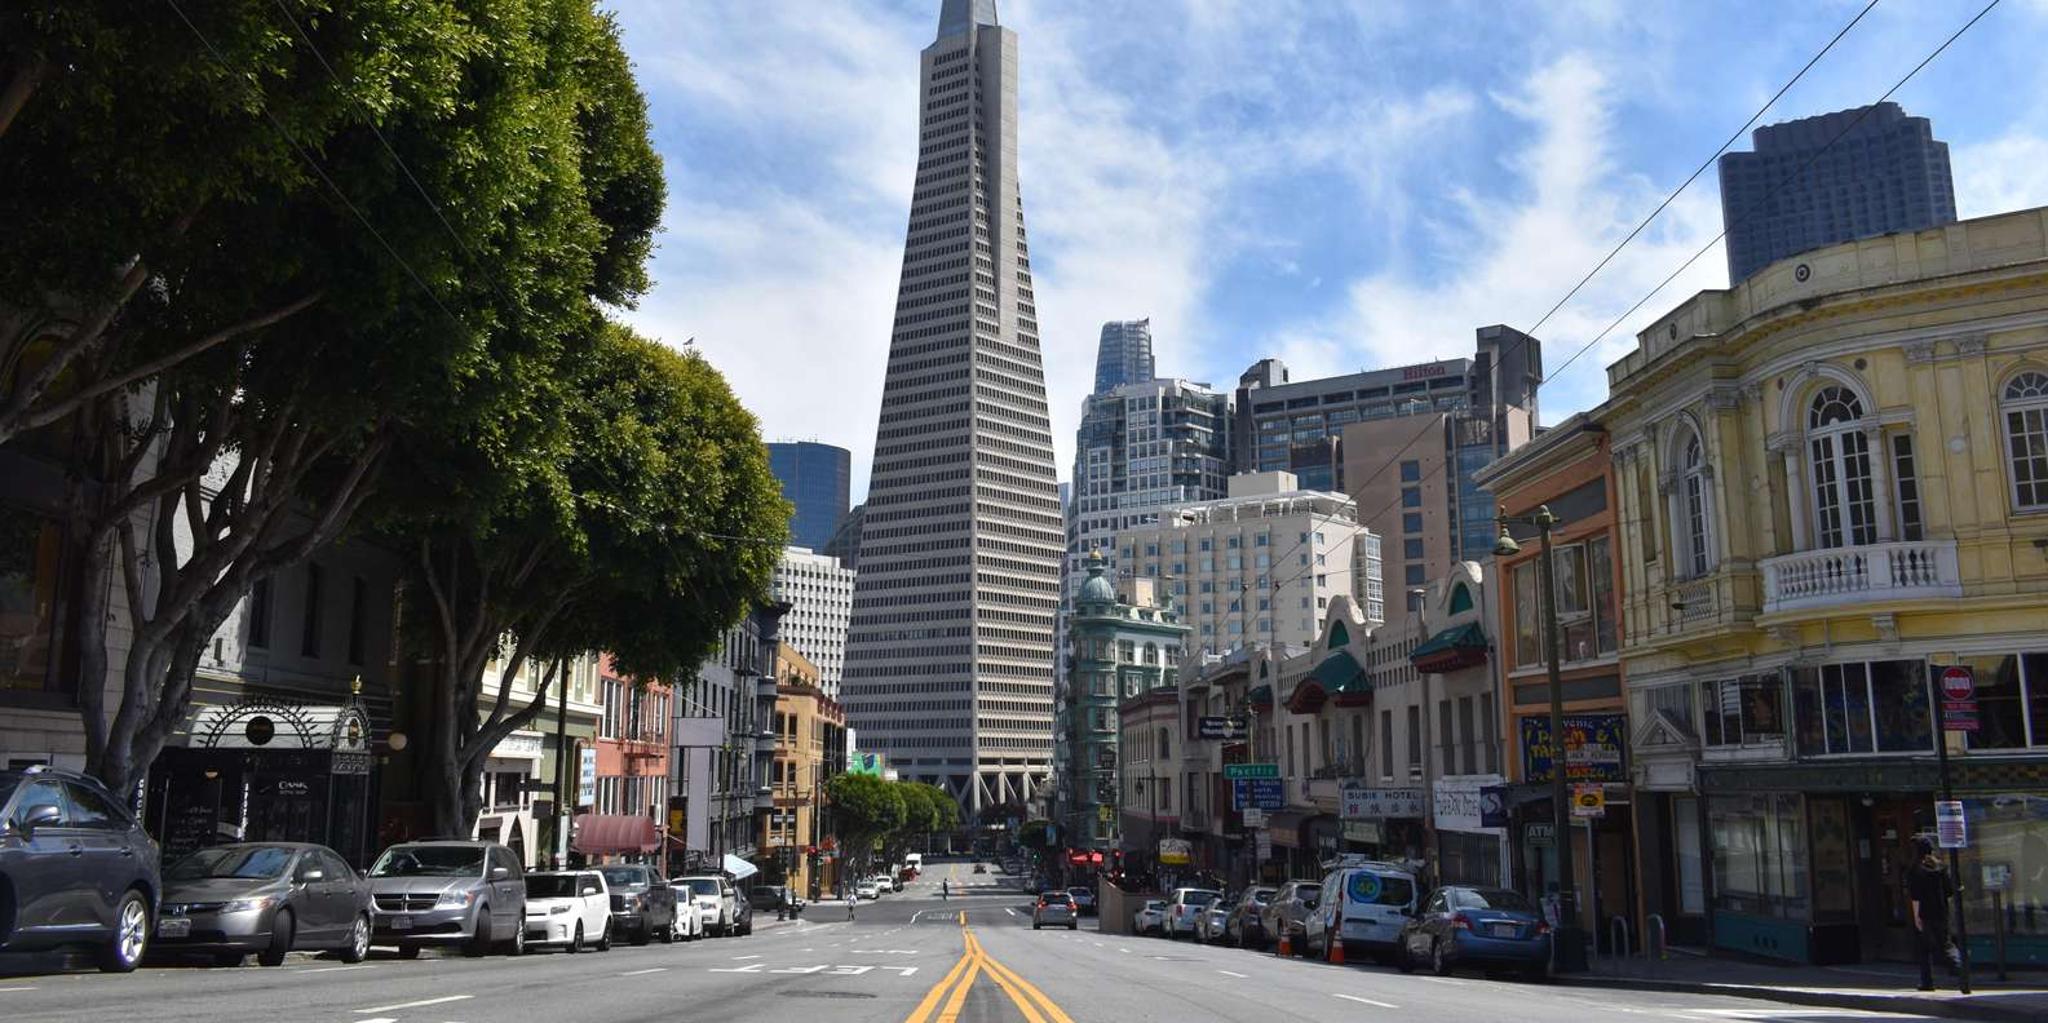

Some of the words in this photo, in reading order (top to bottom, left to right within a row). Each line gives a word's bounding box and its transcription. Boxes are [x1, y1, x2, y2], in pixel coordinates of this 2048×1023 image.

[1403, 366, 1445, 380] Hilton
[1230, 766, 1275, 777] Pacific
[1385, 791, 1418, 800] HOTEL
[1528, 825, 1553, 838] ATM
